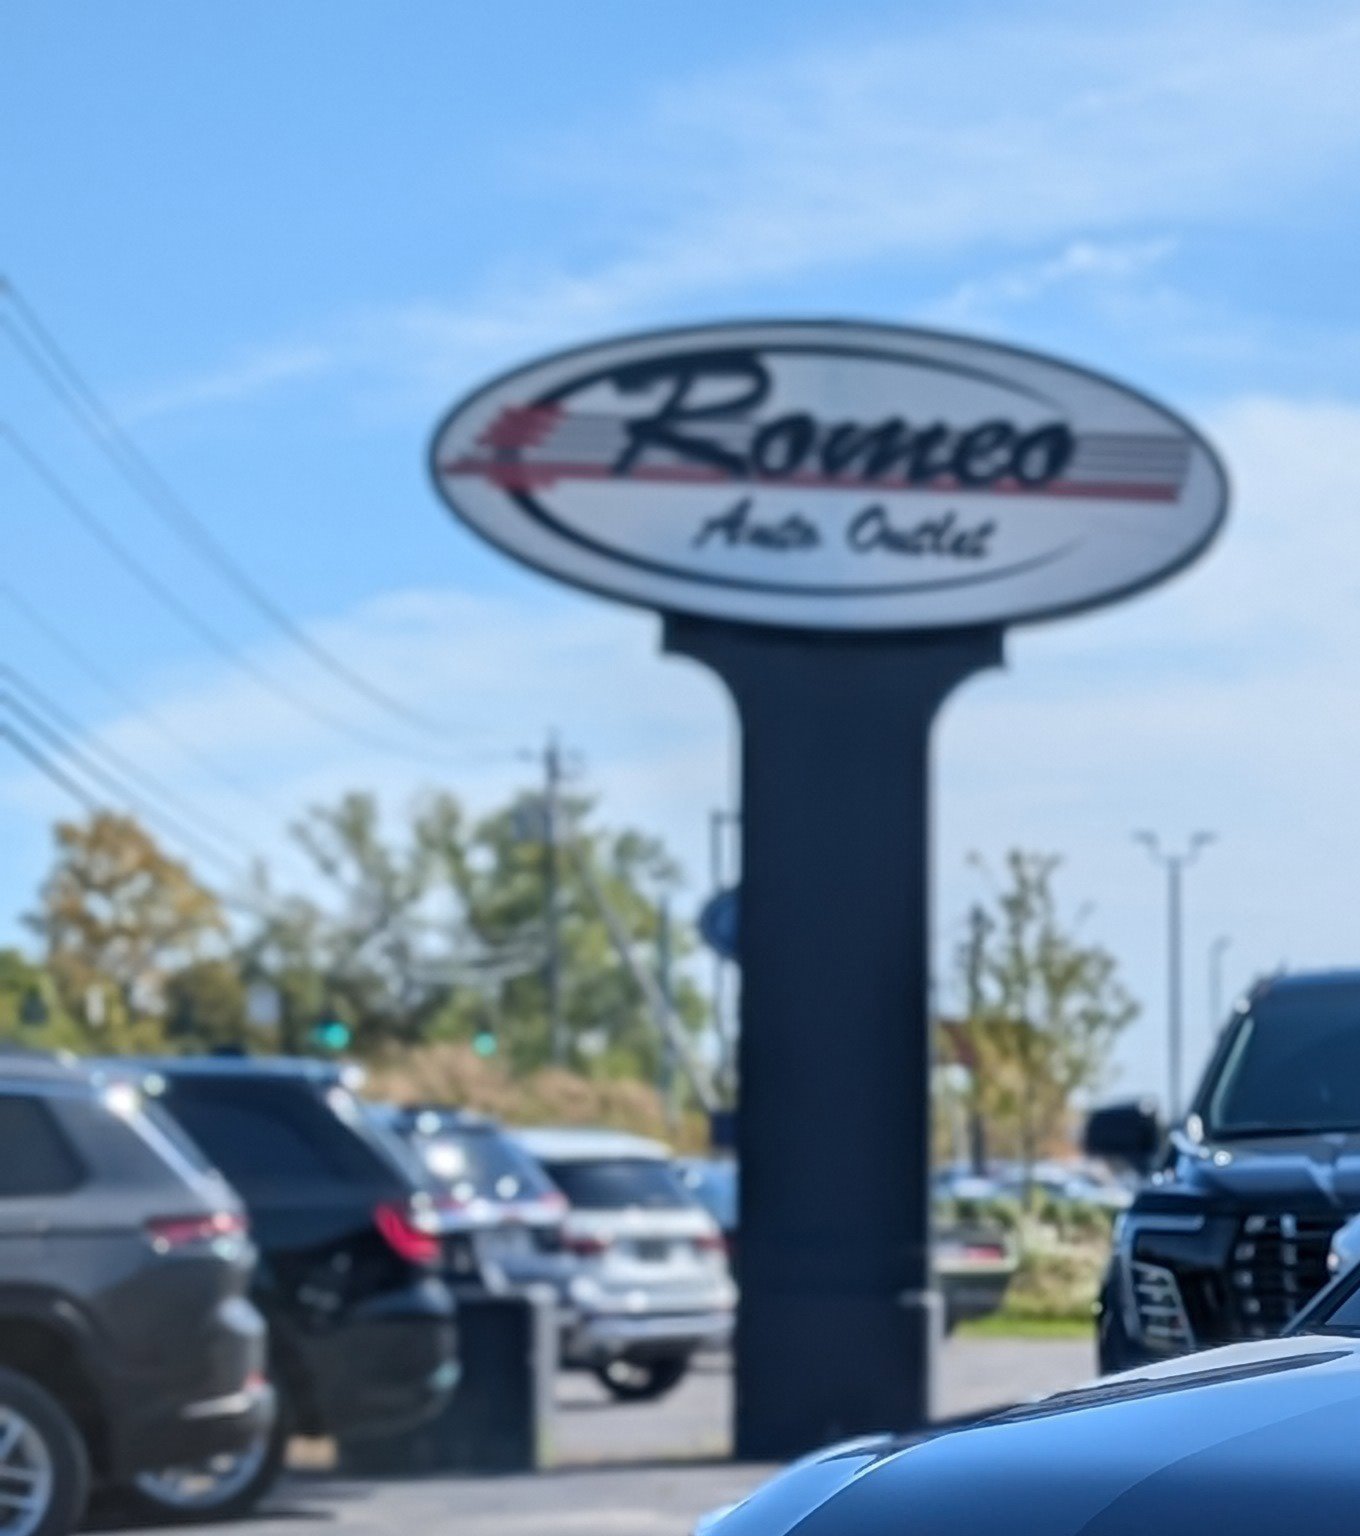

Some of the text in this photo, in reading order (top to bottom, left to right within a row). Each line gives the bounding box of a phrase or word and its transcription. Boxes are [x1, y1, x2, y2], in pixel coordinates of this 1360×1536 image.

[604, 351, 1076, 487] Romeo
[693, 500, 996, 560] Auto Outlet
